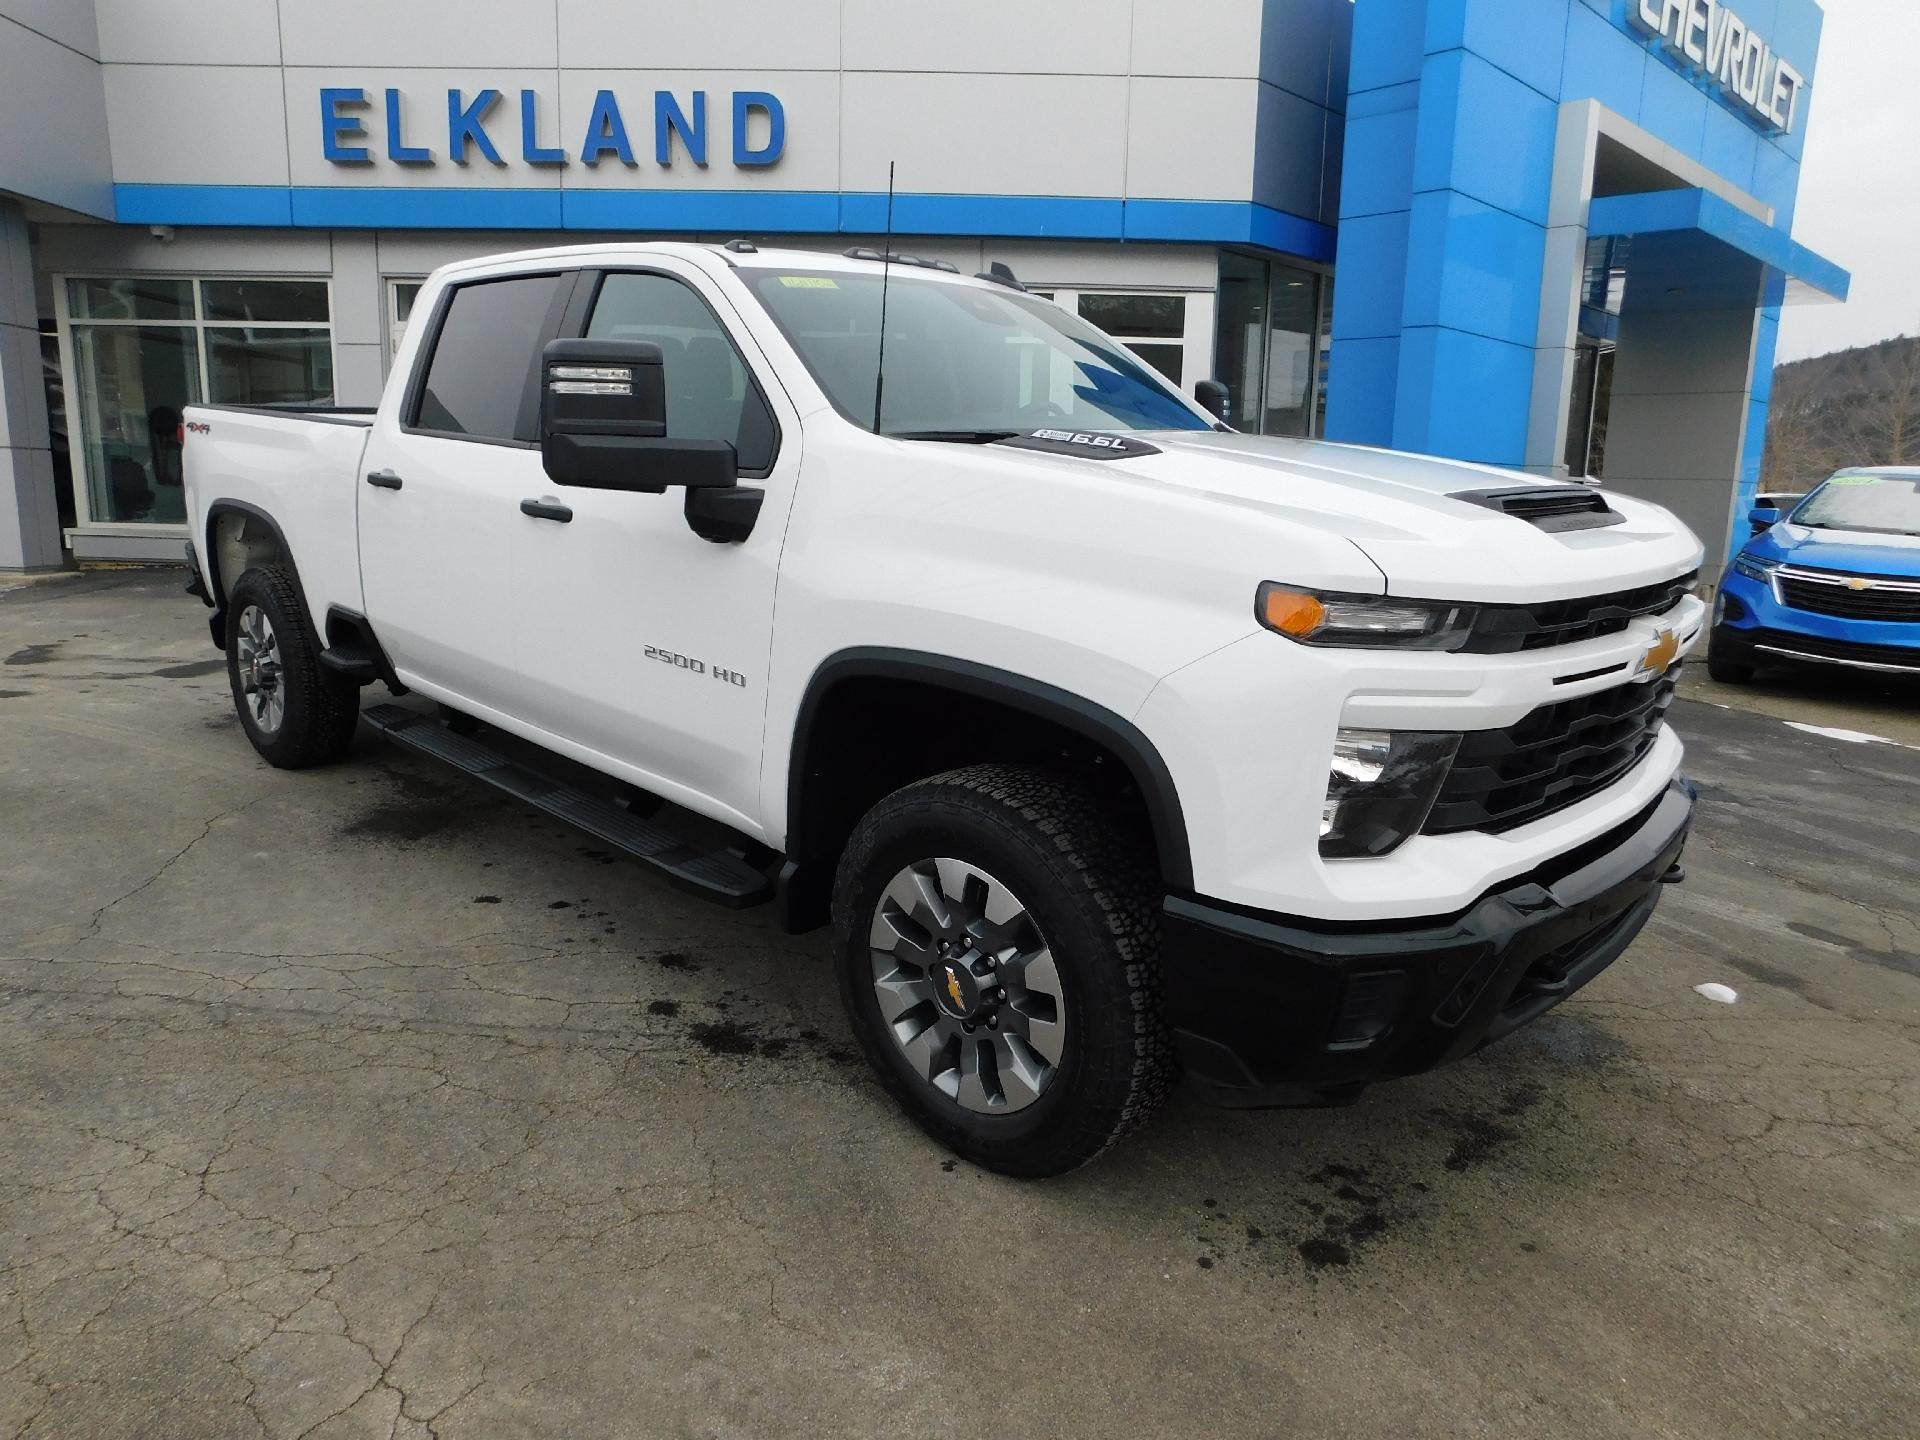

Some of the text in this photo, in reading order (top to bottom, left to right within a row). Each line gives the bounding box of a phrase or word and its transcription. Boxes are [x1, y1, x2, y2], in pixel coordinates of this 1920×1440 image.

[319, 87, 786, 167] ELKLAND
[1071, 433, 1128, 451] 6.6L
[643, 643, 747, 688] 2500 HD
